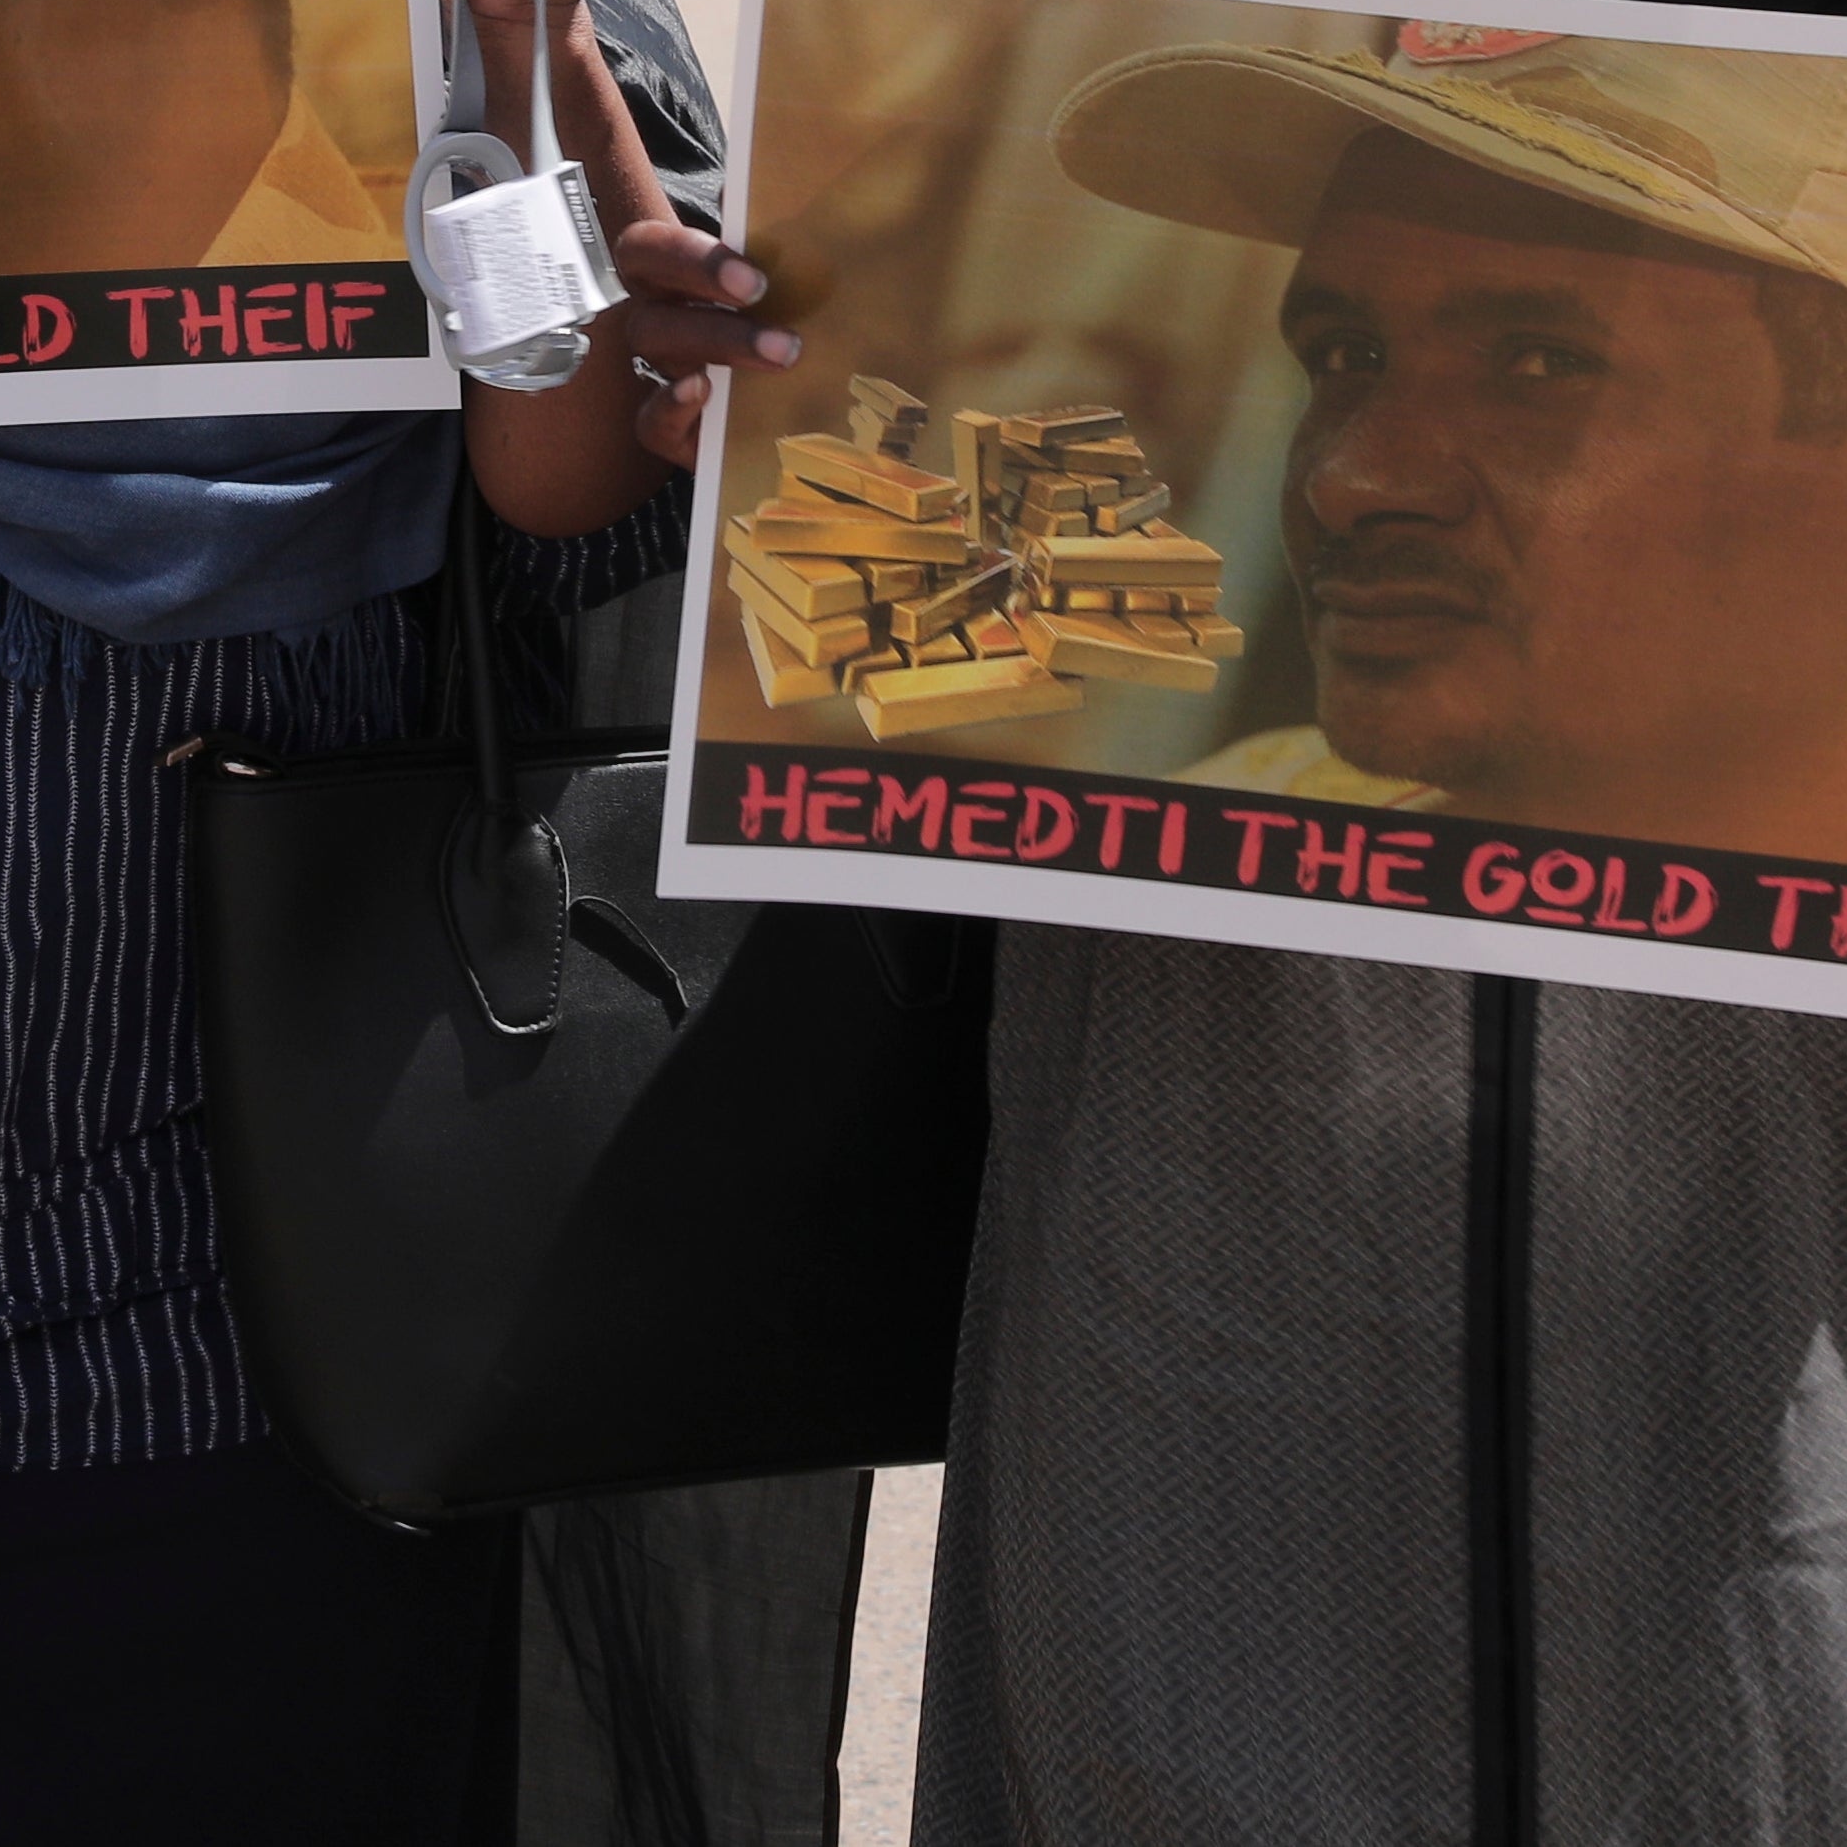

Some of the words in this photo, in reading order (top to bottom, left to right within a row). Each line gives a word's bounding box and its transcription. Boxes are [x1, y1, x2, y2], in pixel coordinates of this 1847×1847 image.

[106, 282, 386, 359] THEIF
[739, 764, 1187, 875] HEMEDTI
[1222, 809, 1434, 905] THE
[1462, 842, 1717, 937] GOLD
